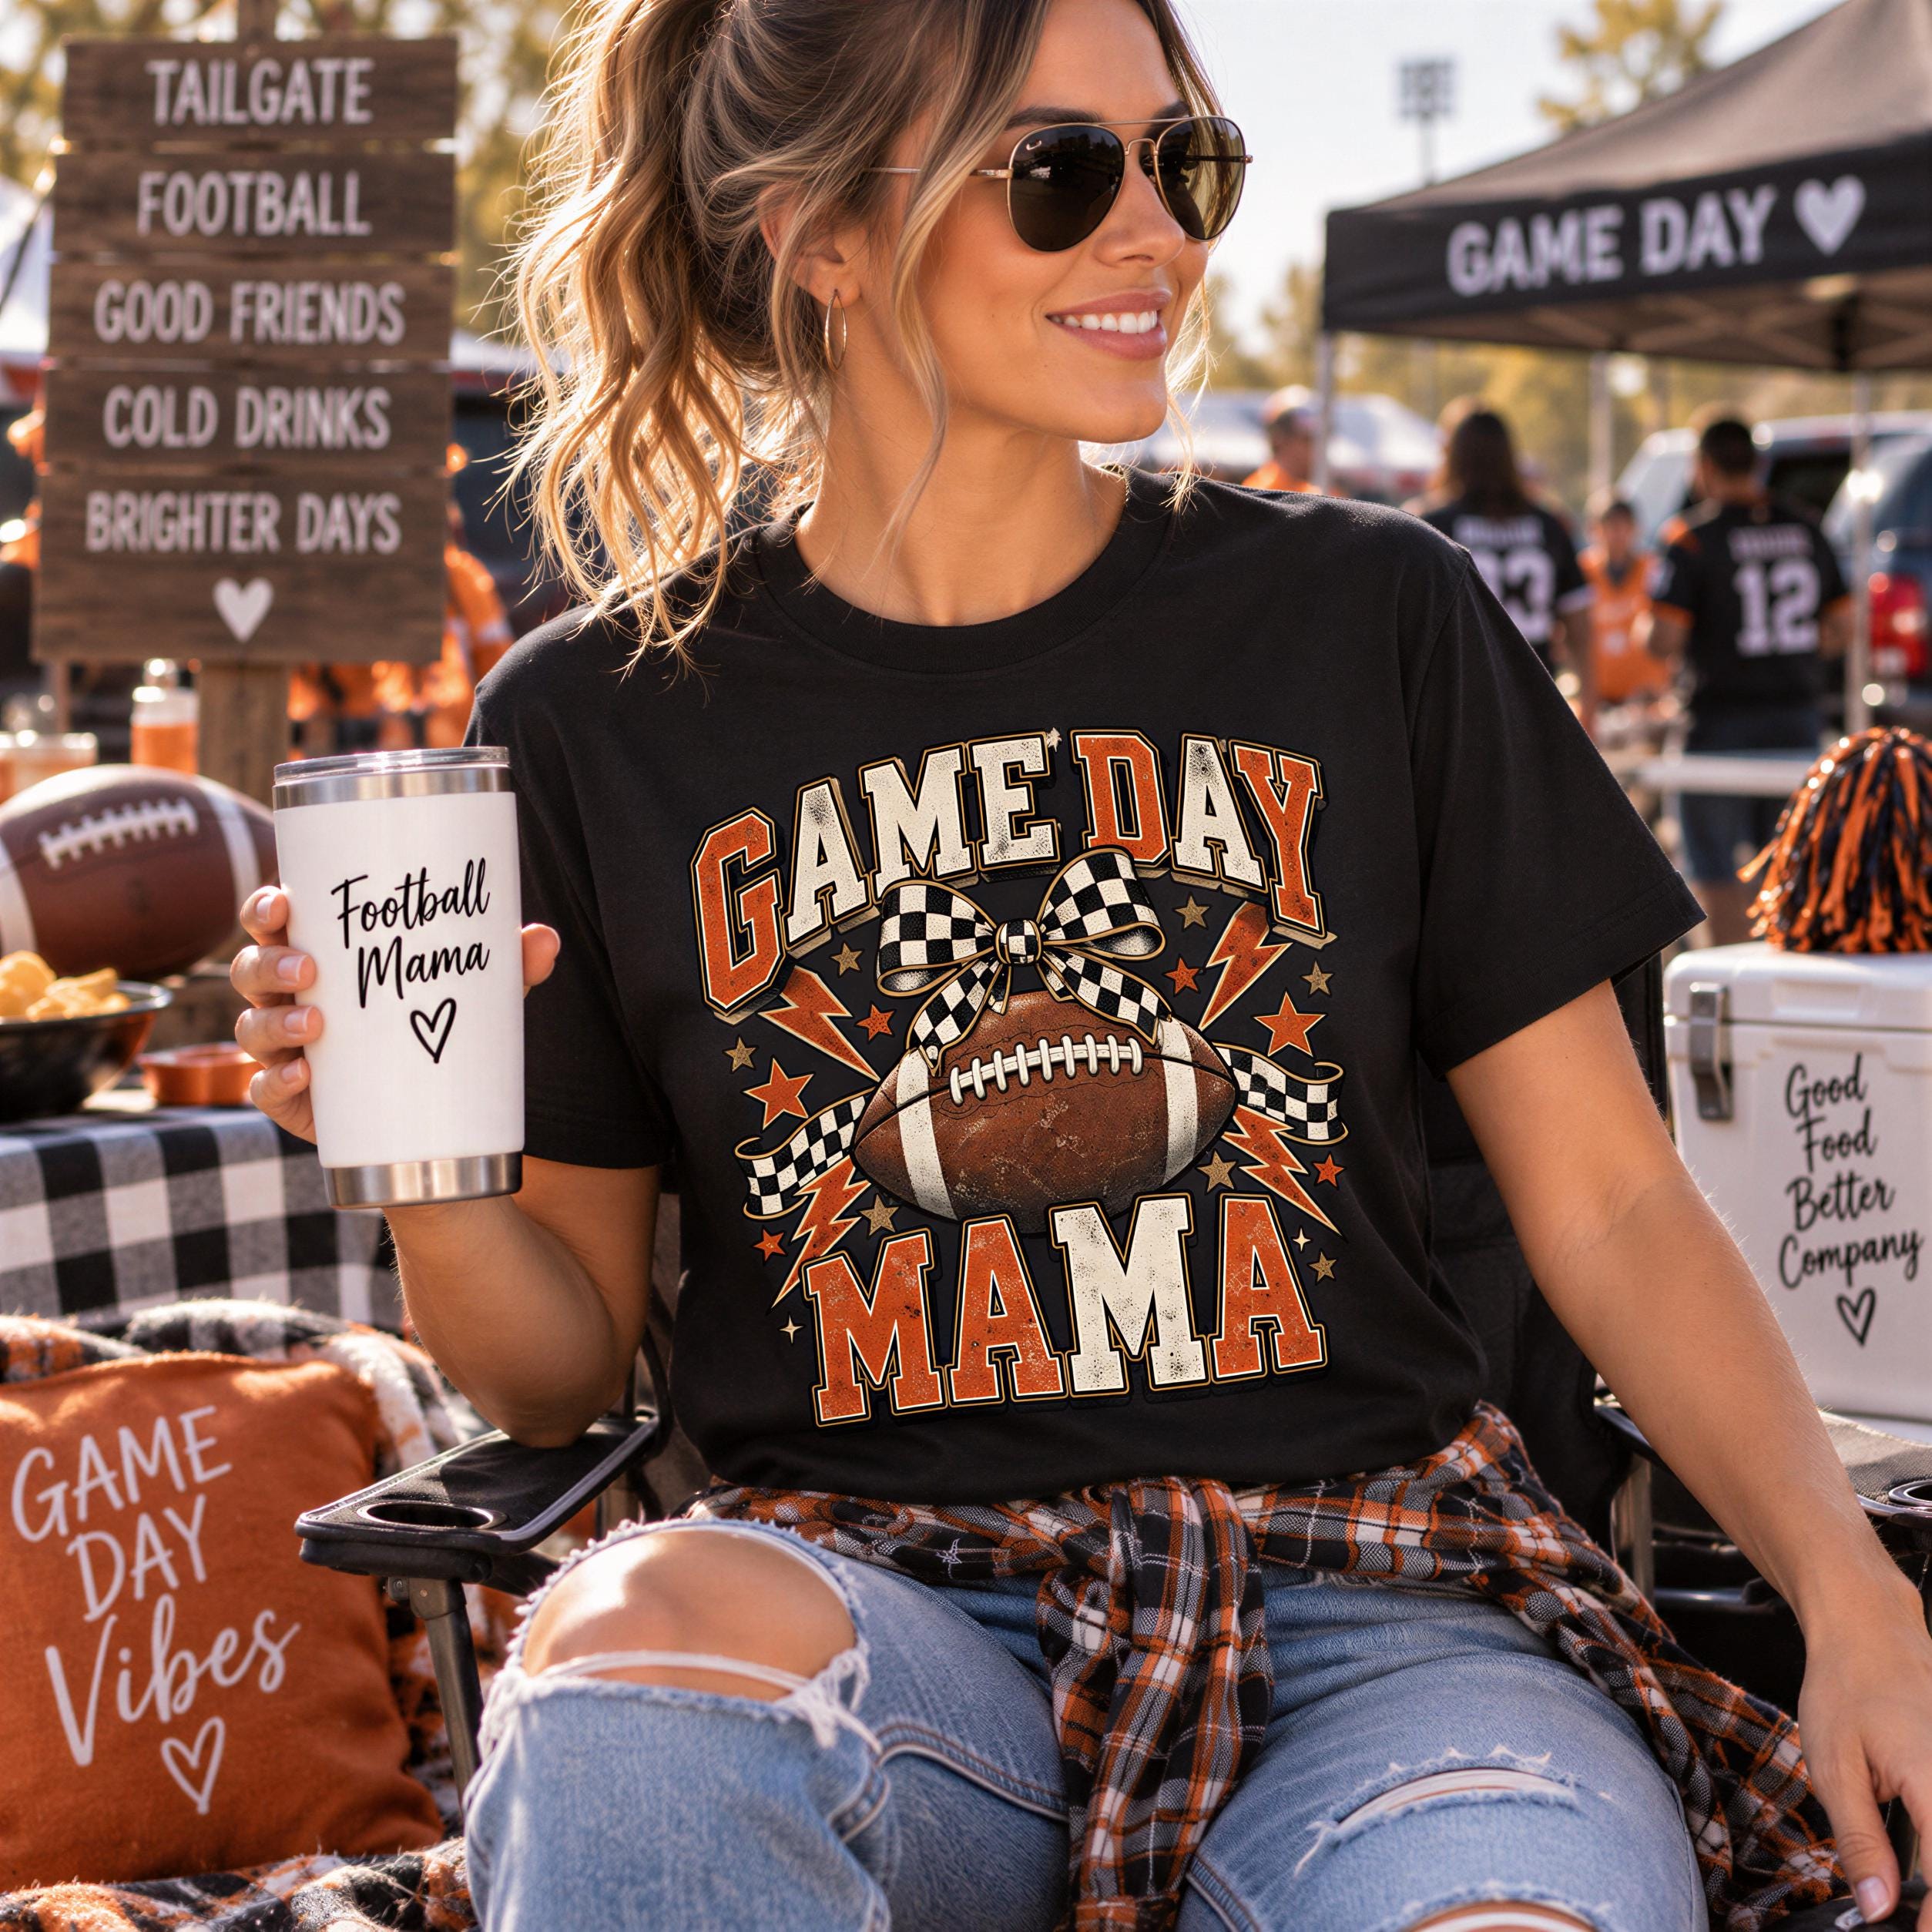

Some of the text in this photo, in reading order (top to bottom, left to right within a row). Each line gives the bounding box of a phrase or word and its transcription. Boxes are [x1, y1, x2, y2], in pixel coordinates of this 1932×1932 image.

[146, 58, 374, 126] TAILGATE
[137, 169, 371, 236] FOOTBALL
[1447, 185, 1778, 297] GAME DAY
[93, 280, 406, 345] GOOD FRIENDS
[103, 385, 391, 449] COLD DRINKS
[86, 491, 401, 554] BRIGHTER DAYS
[1732, 562, 1820, 656] 12
[330, 857, 491, 949] Football
[689, 728, 1337, 1025] GAME DAY
[357, 935, 490, 1009] Mama
[1785, 1052, 1868, 1120] Good
[1796, 1106, 1878, 1172] Food
[1785, 1170, 1895, 1232] Better
[1778, 1228, 1924, 1291] Company
[800, 1191, 1330, 1430] MAMA
[12, 1405, 231, 1541] GAME
[66, 1494, 206, 1622] DAY
[45, 1593, 301, 1766] Vibes
